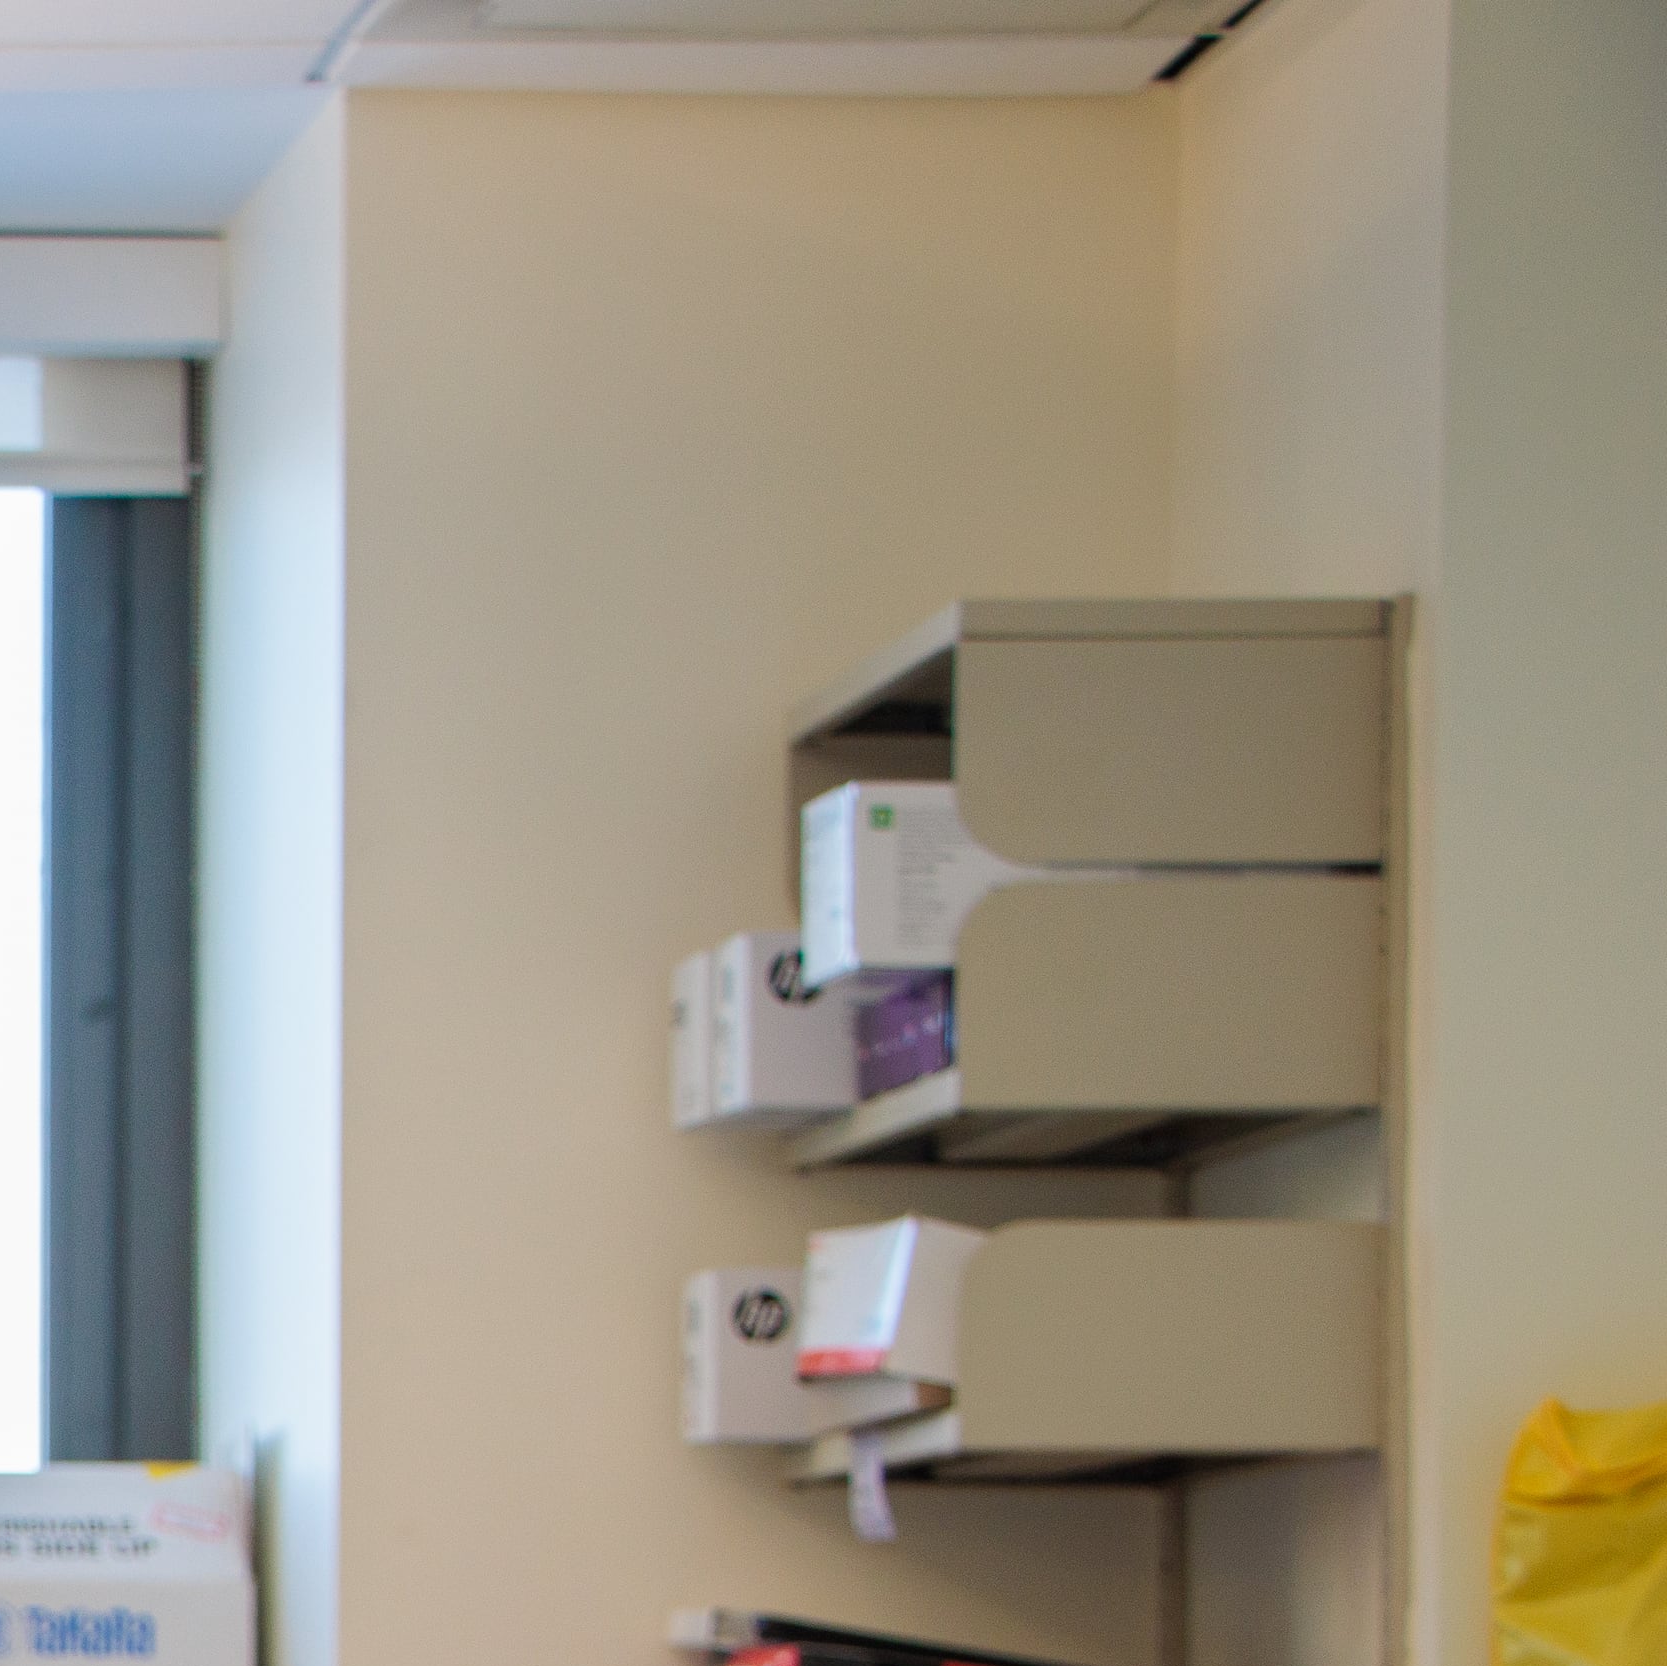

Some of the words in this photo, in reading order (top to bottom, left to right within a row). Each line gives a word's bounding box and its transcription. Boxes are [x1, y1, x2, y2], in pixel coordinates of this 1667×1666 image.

[736, 1289, 788, 1341] hp
[30, 1537, 101, 1557] SIDE
[112, 1537, 157, 1557] UP
